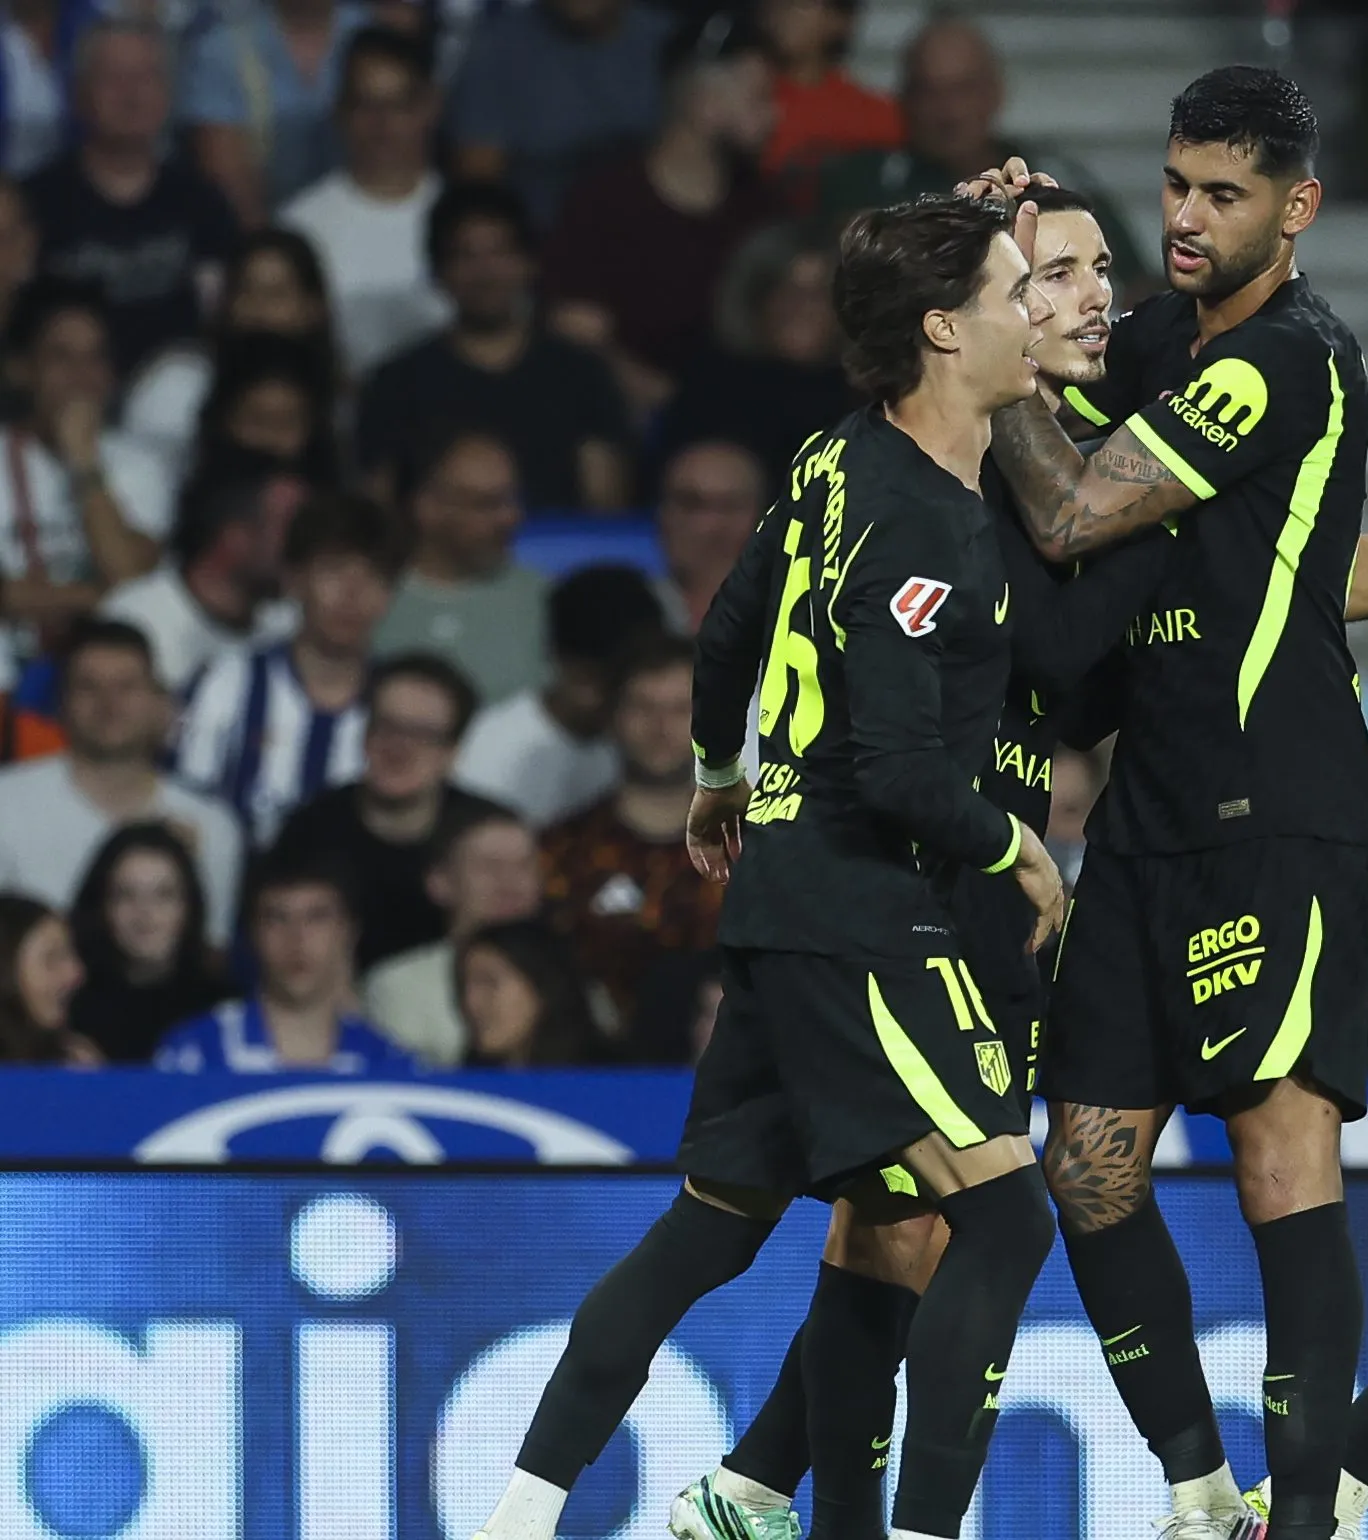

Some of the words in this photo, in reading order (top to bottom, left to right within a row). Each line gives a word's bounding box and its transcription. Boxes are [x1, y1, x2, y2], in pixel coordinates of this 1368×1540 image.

[1168, 395, 1238, 453] kraken
[1147, 608, 1202, 645] AIR
[1188, 914, 1260, 963] ERGO
[1192, 959, 1262, 1006] DKV
